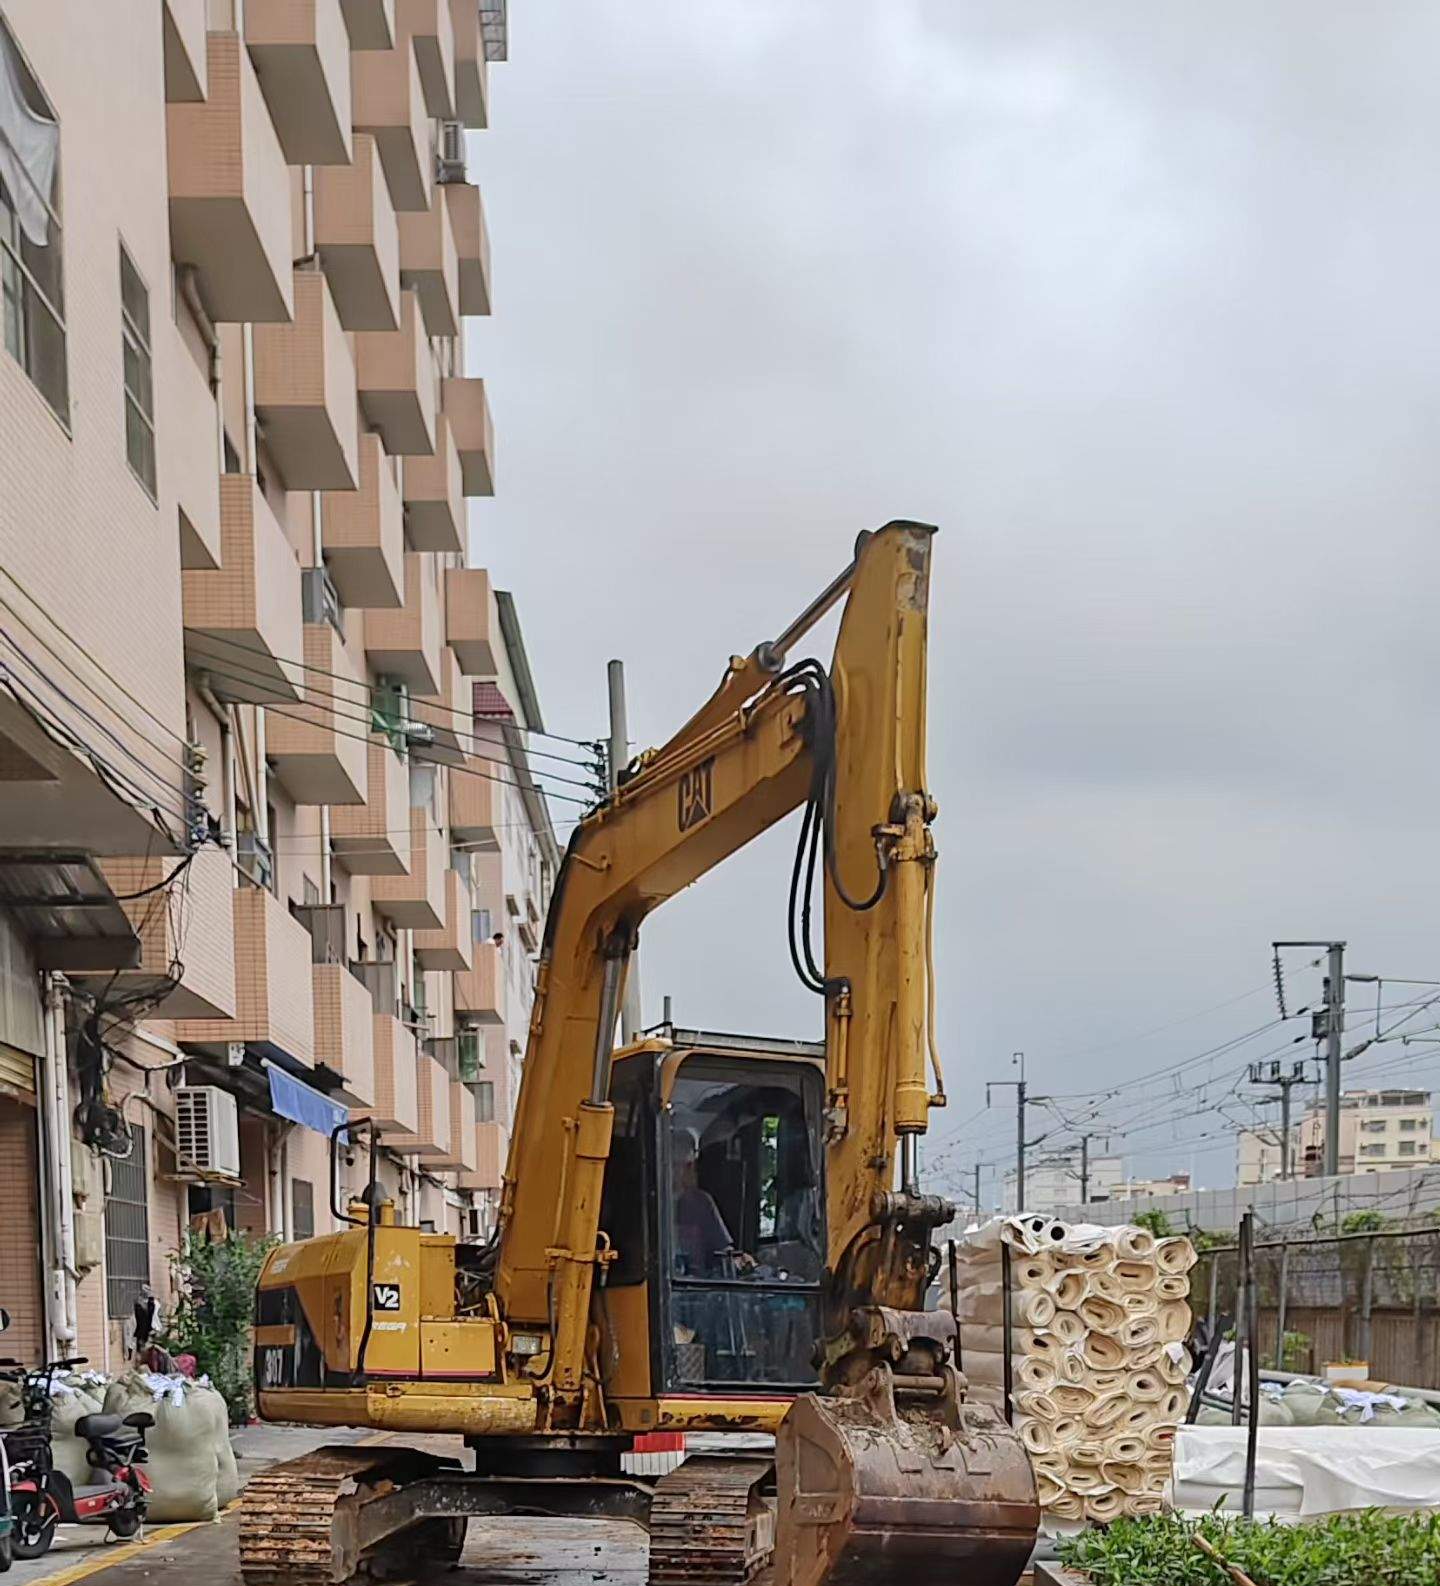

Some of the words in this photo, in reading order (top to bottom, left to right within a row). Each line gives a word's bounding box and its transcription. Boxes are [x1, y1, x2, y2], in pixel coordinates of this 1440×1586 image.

[678, 754, 716, 833] CAT
[374, 1286, 399, 1308] V2
[265, 1348, 284, 1384] 307
